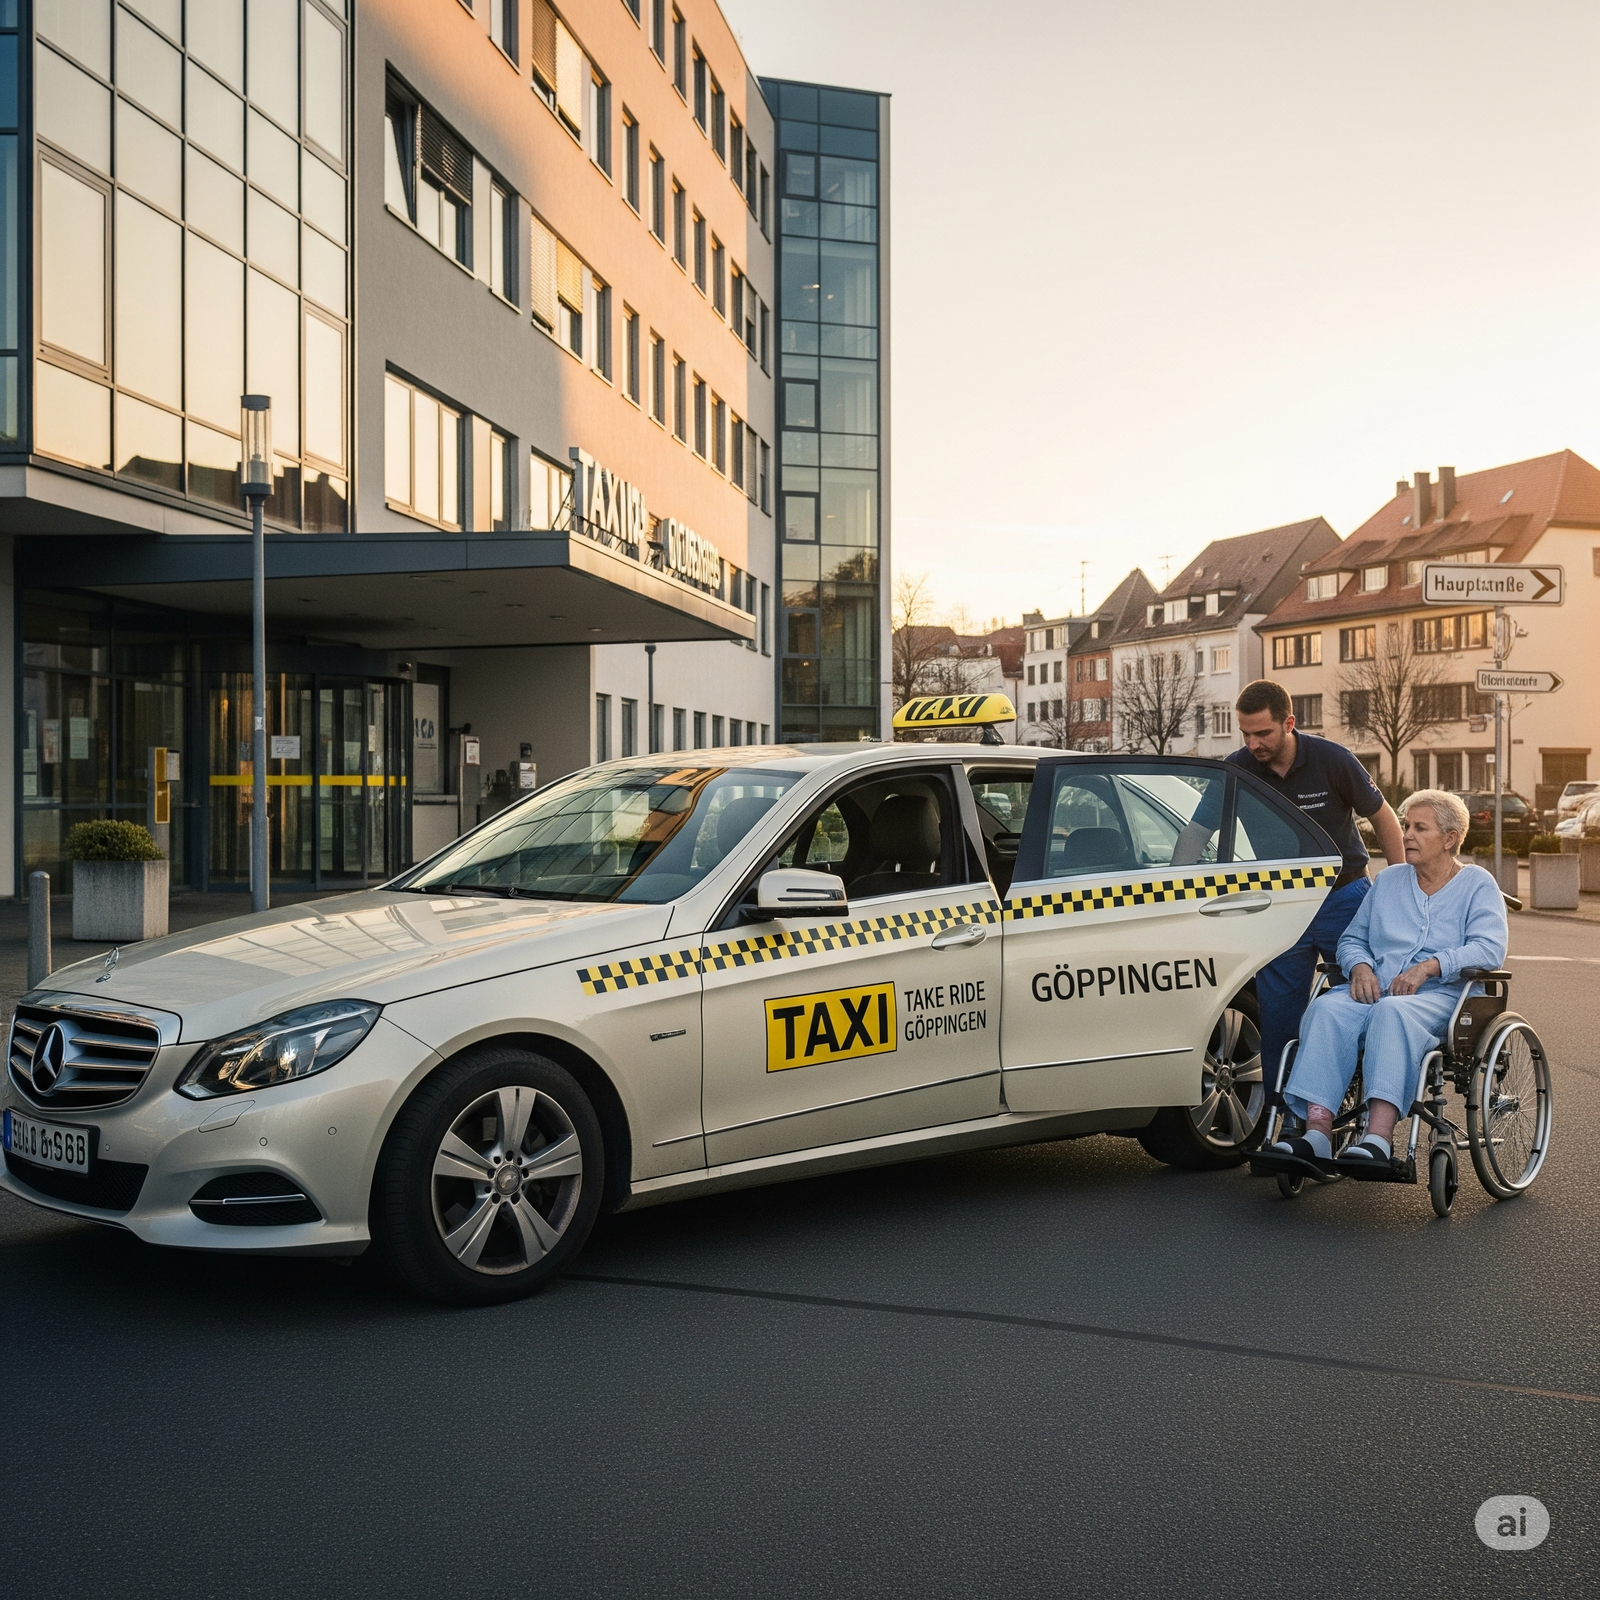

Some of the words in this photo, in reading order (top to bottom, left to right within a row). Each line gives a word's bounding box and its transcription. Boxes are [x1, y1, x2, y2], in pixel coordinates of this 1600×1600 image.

[905, 696, 987, 721] TAXI
[904, 986, 945, 1012] TAKE
[949, 980, 986, 1006] RIDE
[1031, 957, 1217, 1003] GÖPPINGEN
[772, 992, 889, 1061] TAXI
[904, 1009, 986, 1042] GÖPPINGEN
